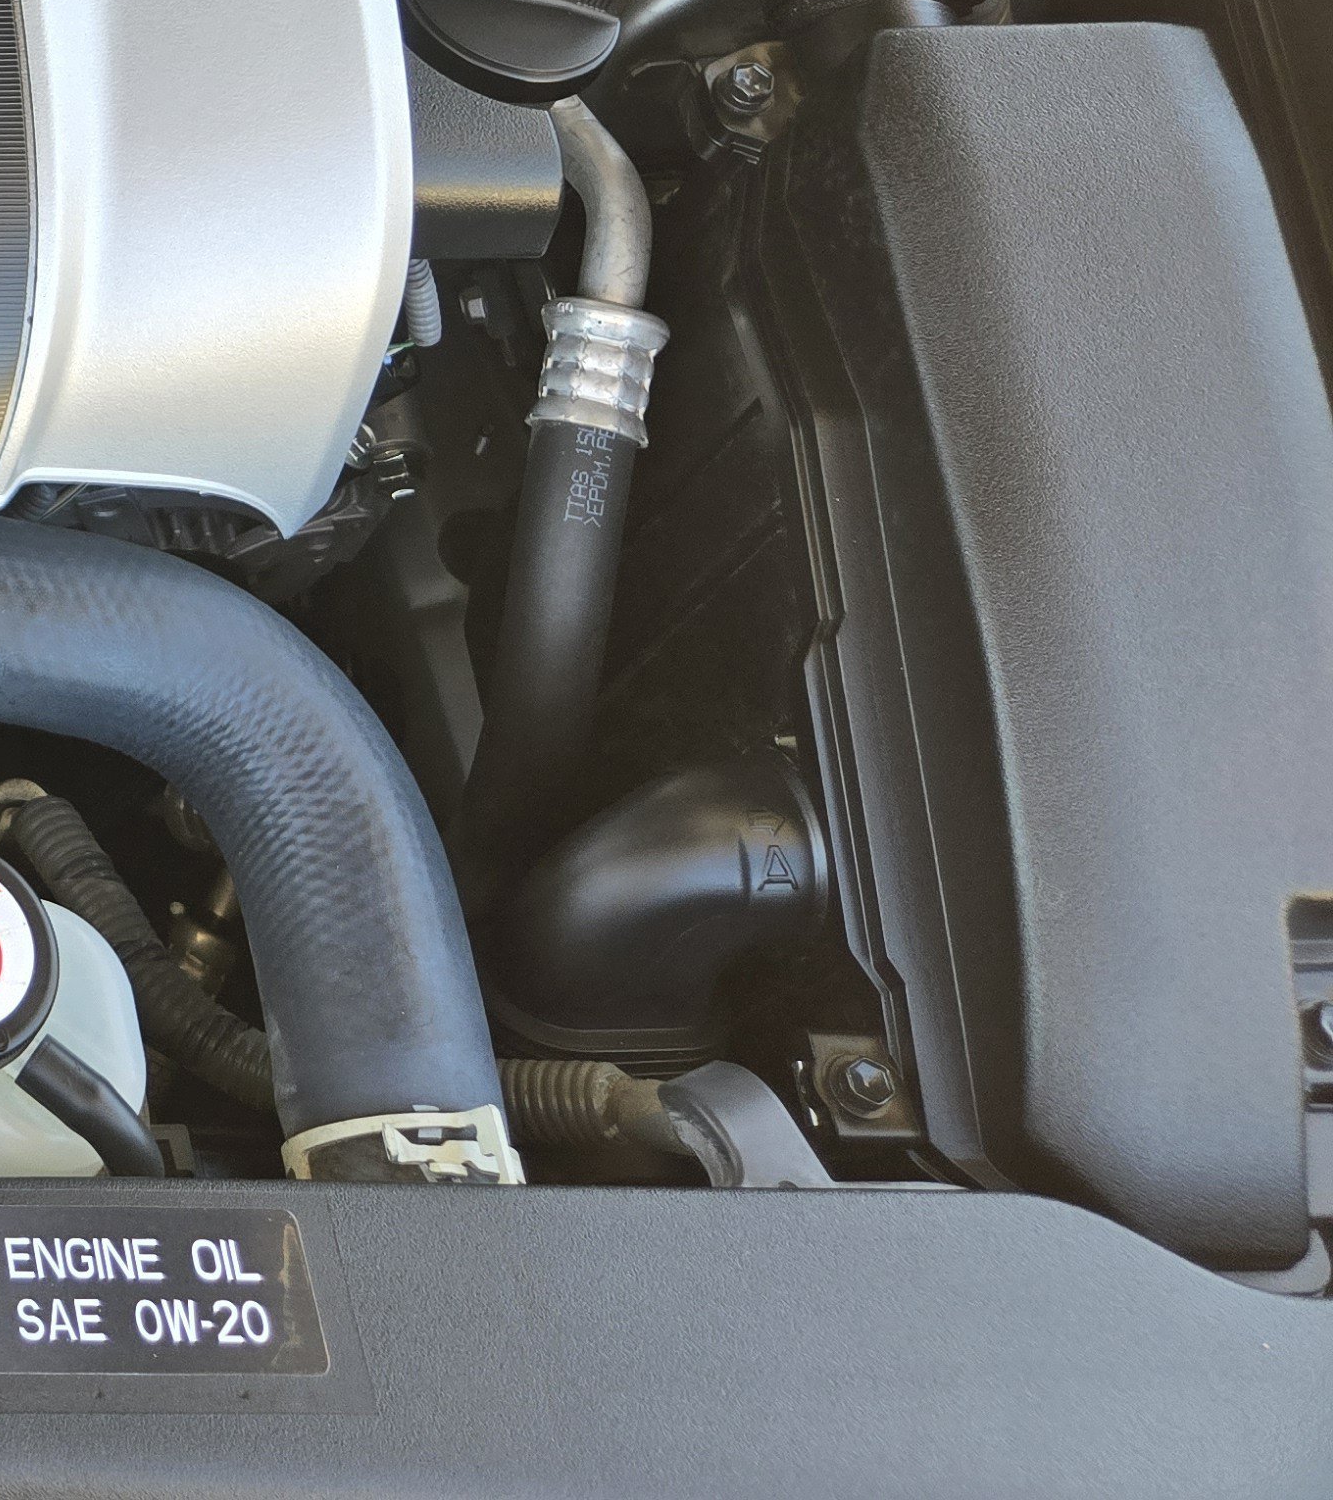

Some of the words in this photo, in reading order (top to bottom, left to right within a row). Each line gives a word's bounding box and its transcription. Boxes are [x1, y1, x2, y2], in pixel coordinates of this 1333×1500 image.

[5, 1237, 165, 1281] ENGINE
[191, 1238, 263, 1283] OIL
[16, 1298, 108, 1342] SAE
[134, 1299, 271, 1346] 0W-20
